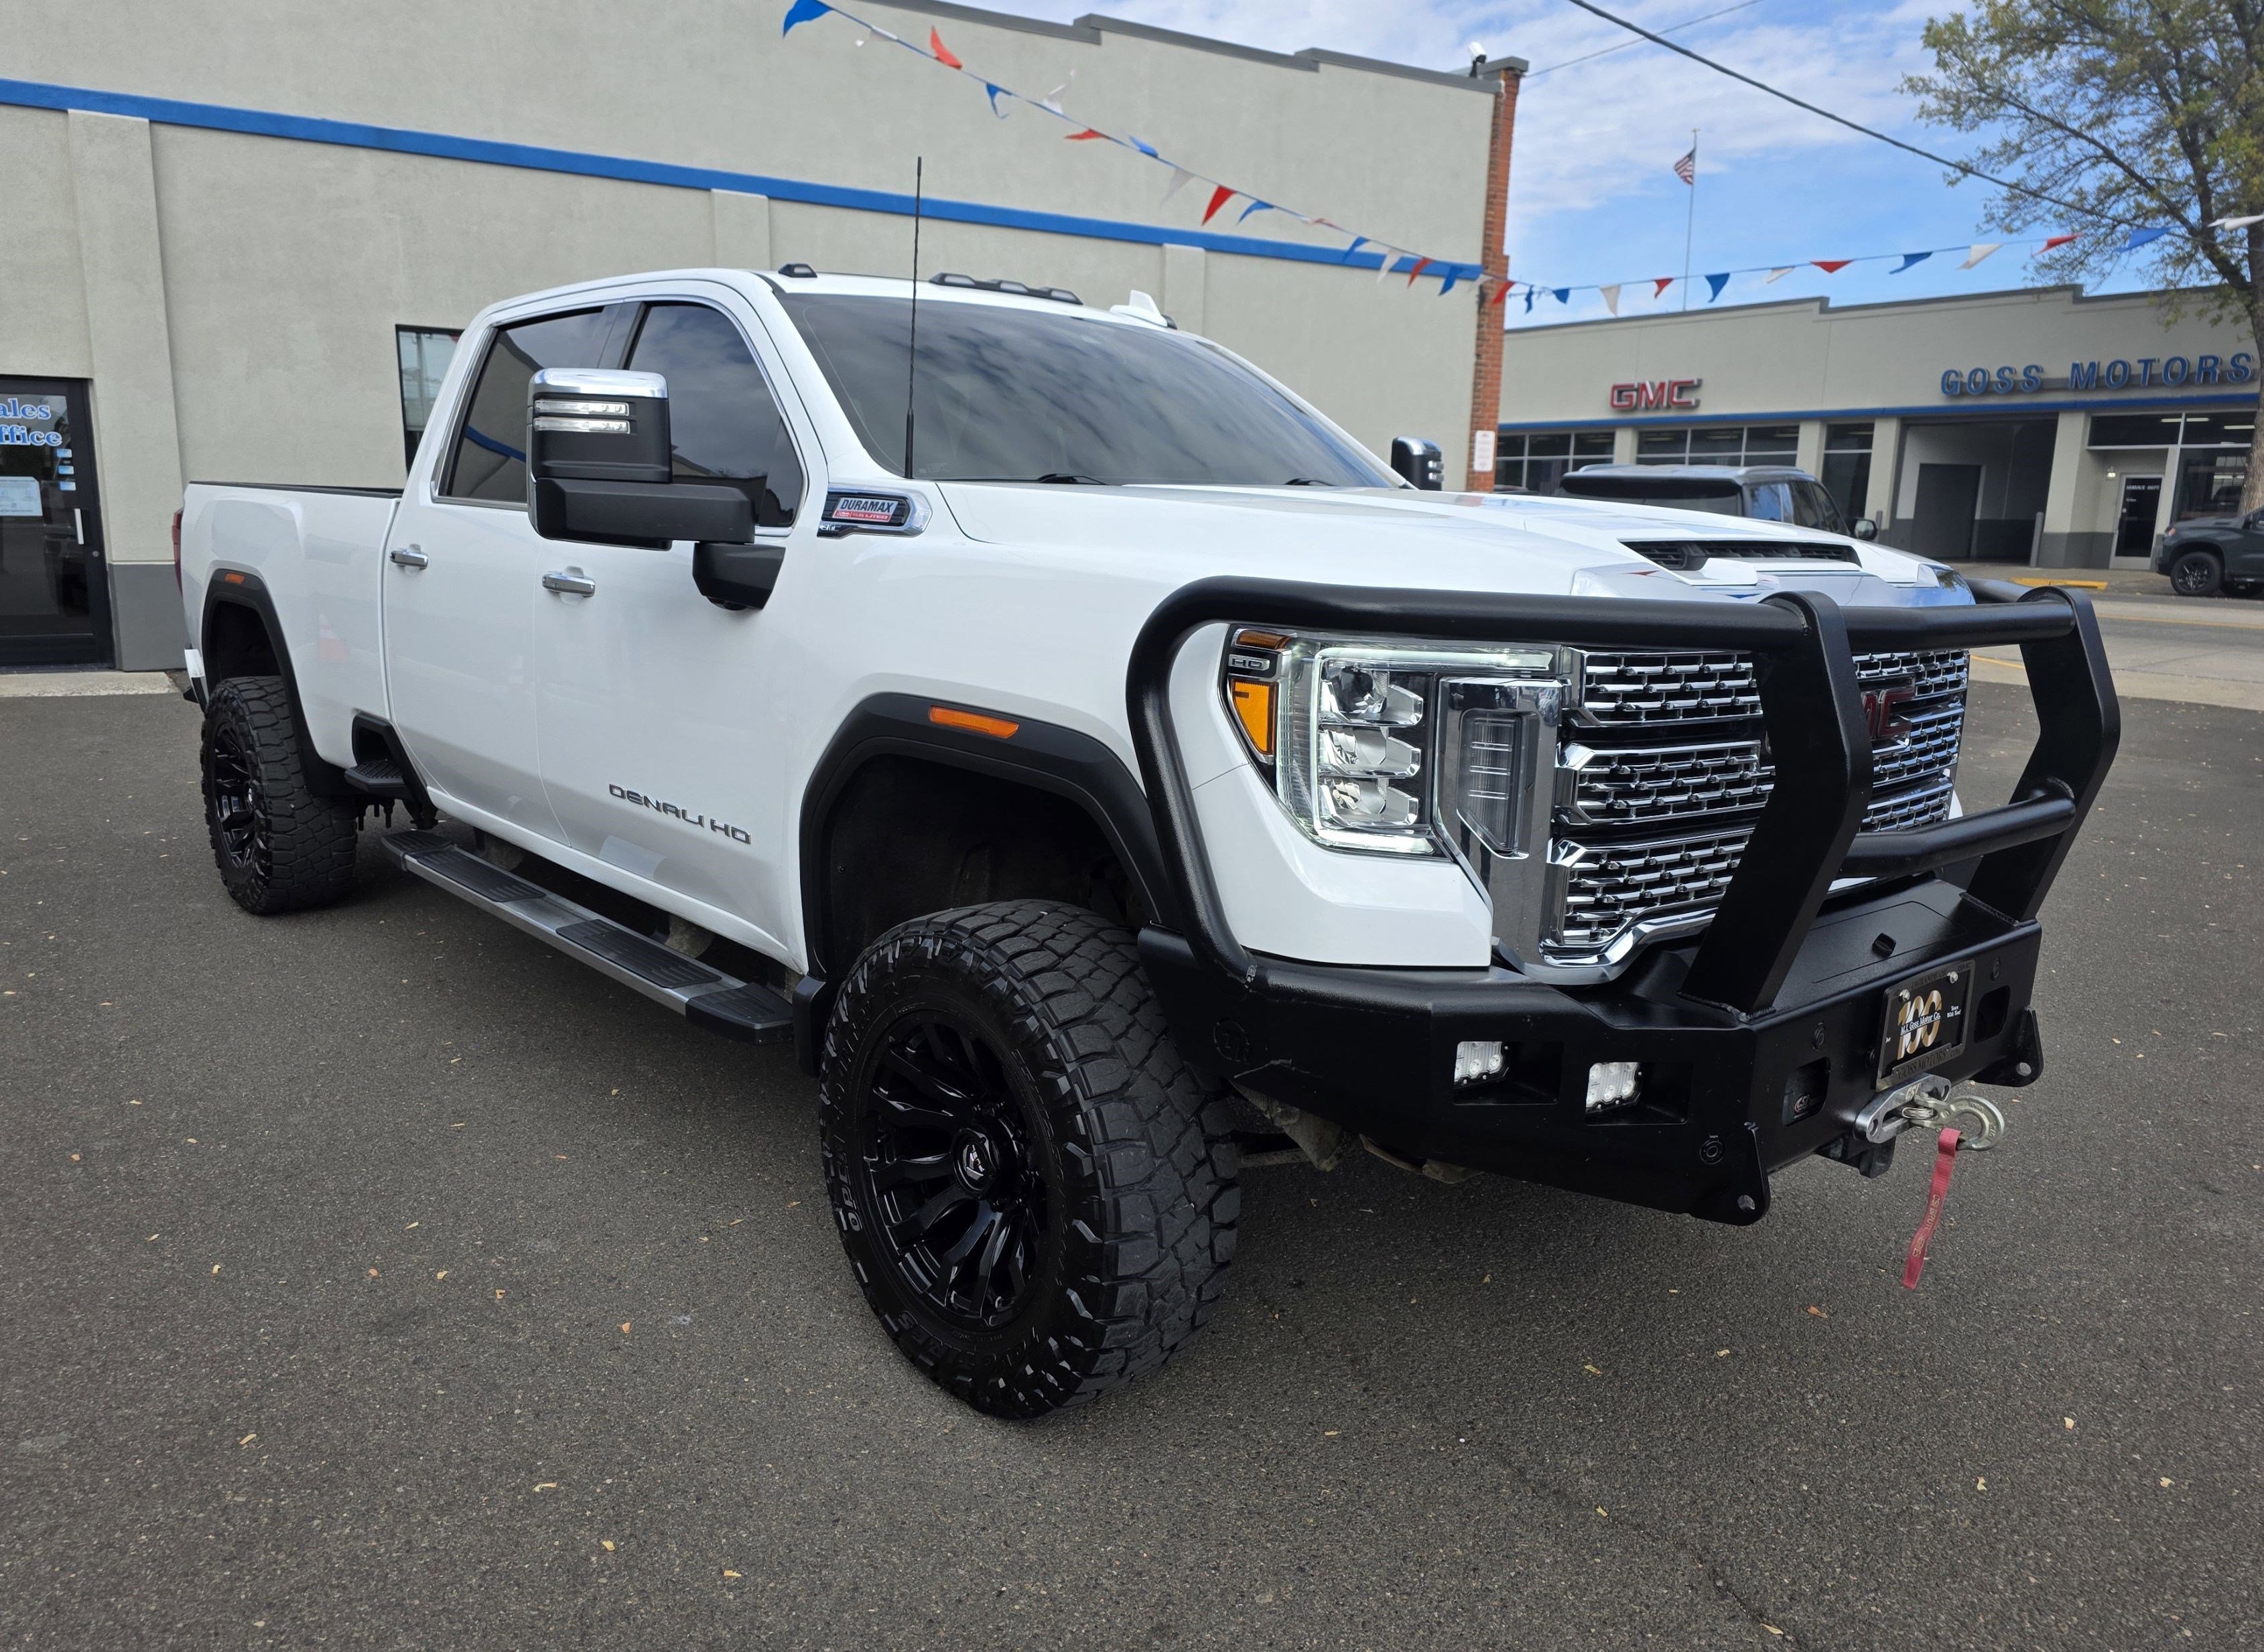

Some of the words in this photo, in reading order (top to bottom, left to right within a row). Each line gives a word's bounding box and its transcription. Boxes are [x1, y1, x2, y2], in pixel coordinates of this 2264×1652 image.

[1940, 364, 2044, 397] GOSS
[2068, 352, 2254, 391] MOTORS
[1610, 378, 1699, 409] GMC
[0, 397, 52, 420] ales
[0, 424, 62, 447] ffice
[840, 499, 894, 513] DURAMAX
[1232, 657, 1263, 669] HD
[609, 783, 705, 828] DENALI
[710, 818, 752, 845] HD
[1897, 990, 1942, 1060] 100
[1920, 1014, 1933, 1025] Motor
[1924, 1208, 1937, 1232] BRUTE
